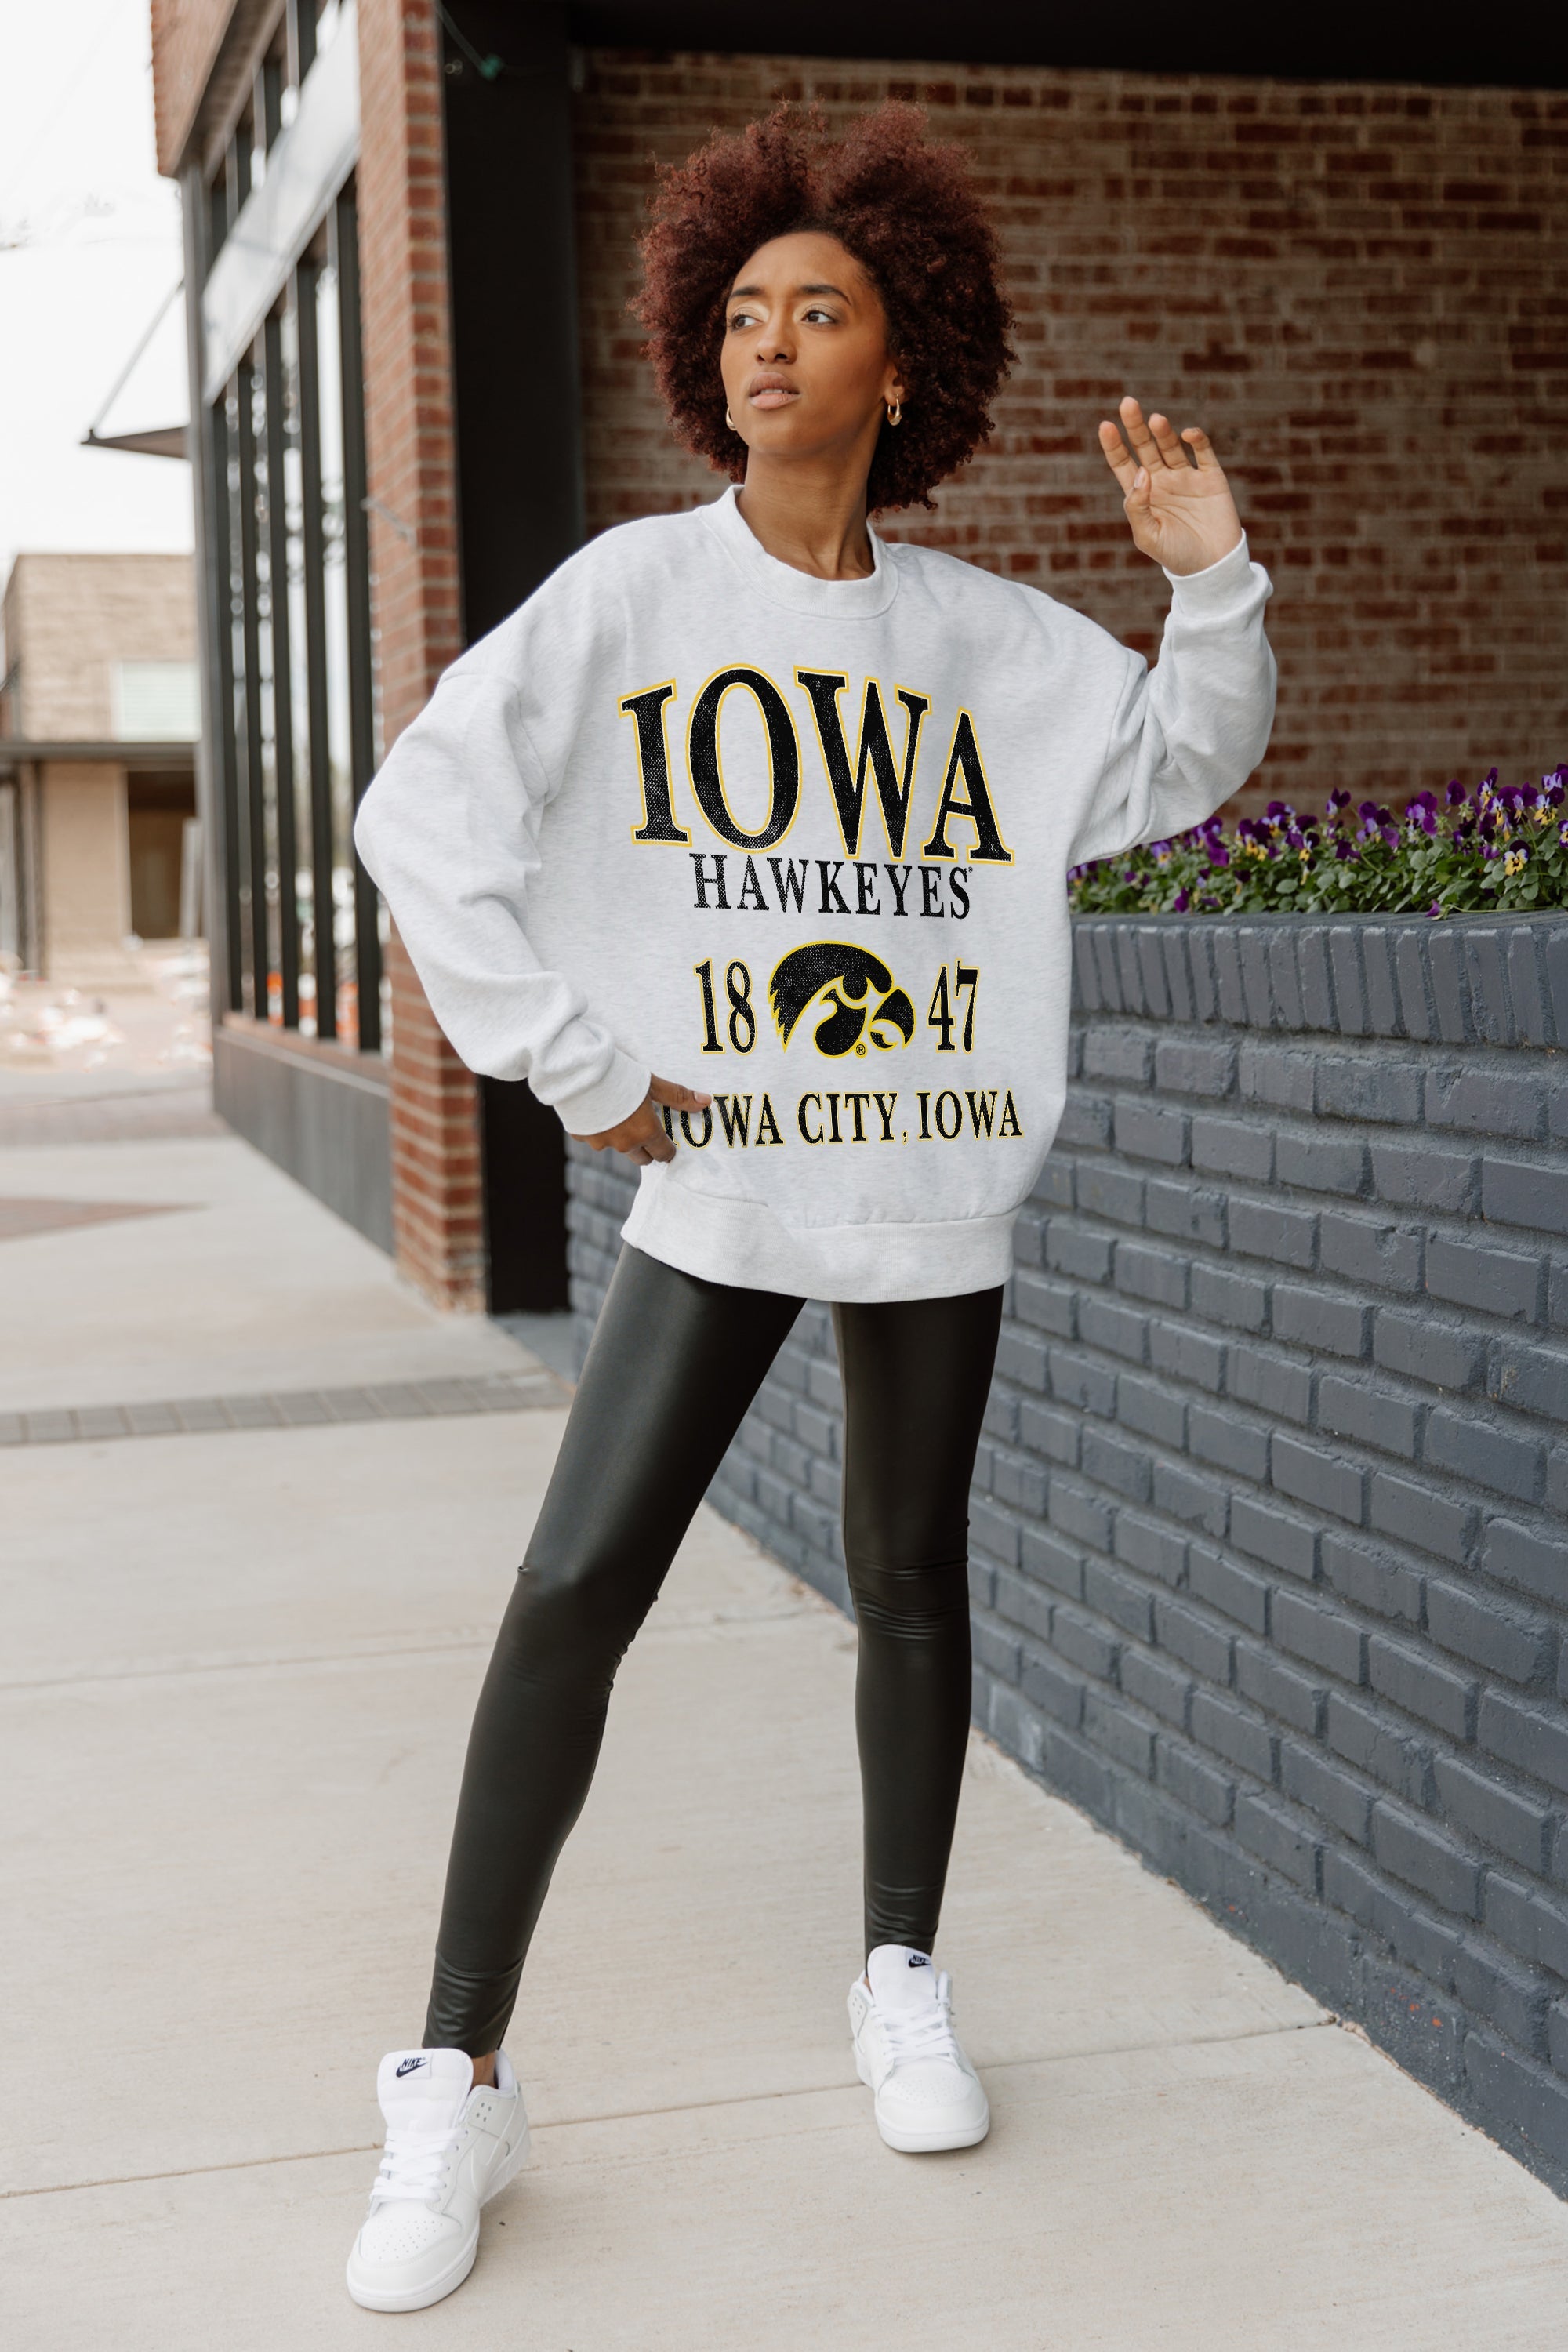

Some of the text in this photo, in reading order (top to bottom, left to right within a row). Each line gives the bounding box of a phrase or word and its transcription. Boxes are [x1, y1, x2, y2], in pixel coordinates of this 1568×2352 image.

[618, 663, 1015, 866] IOWA
[689, 852, 971, 920] HAWKEYES
[693, 957, 980, 1054] 18 47
[797, 1091, 909, 1145] CITY,
[916, 1088, 1023, 1140] IOWA
[401, 2056, 422, 2068] NIKE
